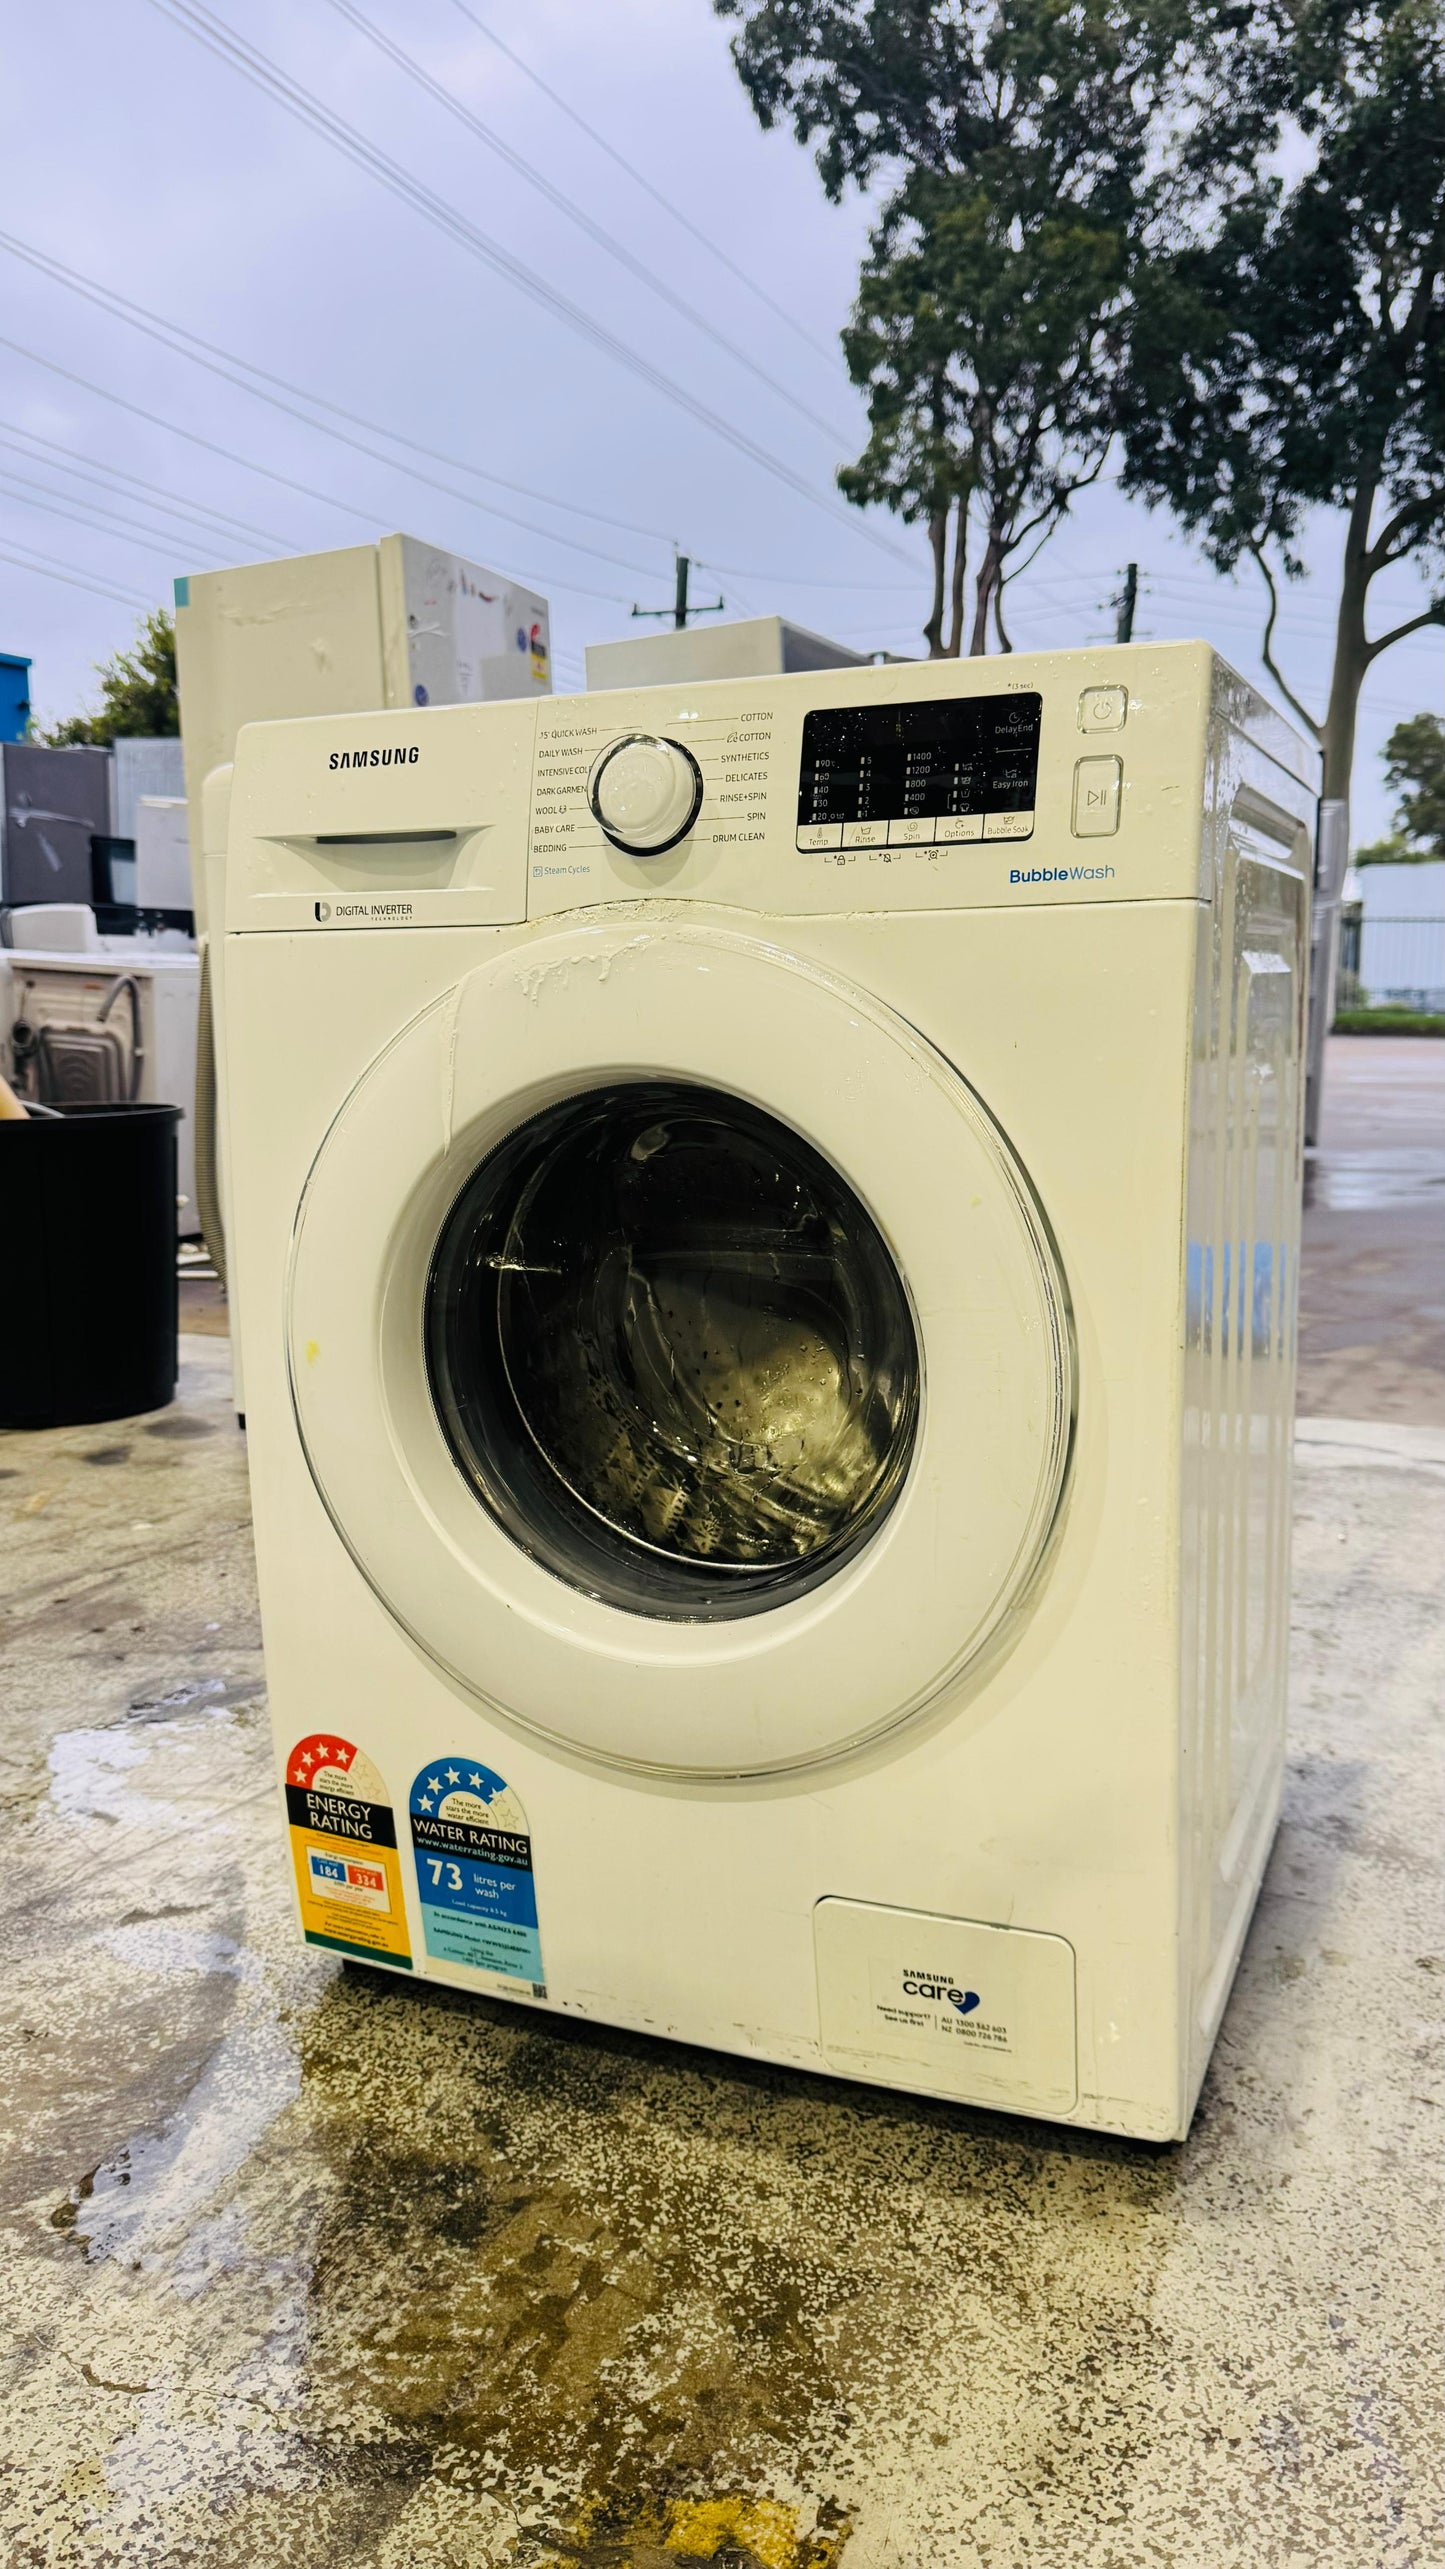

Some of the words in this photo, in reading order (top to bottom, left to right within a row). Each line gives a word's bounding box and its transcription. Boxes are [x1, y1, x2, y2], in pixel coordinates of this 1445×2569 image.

[740, 712, 774, 722] COTTON
[551, 729, 574, 739] QUICK
[575, 728, 598, 737] WASH
[994, 725, 1018, 735] Delay
[1018, 724, 1033, 732] End
[739, 732, 772, 742] COTTON
[328, 746, 420, 770] SAMSUNG
[538, 749, 560, 758] DAILY
[561, 748, 583, 757] WASH
[721, 752, 770, 763] SYNTHETICS
[912, 752, 932, 760] 1400
[537, 767, 574, 777] INTENSIVE
[912, 766, 931, 774] 1200
[725, 771, 768, 782] DELICATES
[910, 780, 926, 788] 800
[992, 781, 1012, 790] Easy
[1012, 780, 1029, 788] Iron
[536, 787, 556, 797] DARK
[556, 785, 588, 795] GARMEN
[818, 786, 829, 794] 40
[720, 792, 767, 803] RINSE+SPIN
[909, 793, 925, 801] 400
[535, 806, 558, 815] WOOL
[817, 812, 827, 820] 20
[747, 812, 766, 821] SPIN
[534, 825, 554, 834] BABY
[555, 824, 576, 833] CARE
[944, 829, 975, 839] Options
[987, 824, 1012, 835] Bubble
[712, 833, 737, 843] DRUM
[738, 832, 766, 842] CLEAN
[809, 838, 829, 847] Temp
[855, 835, 876, 844] Rinse
[903, 833, 921, 841] Spin
[533, 844, 567, 853] BEDDING
[544, 866, 567, 875] Steam
[568, 865, 591, 875] Cycles
[1009, 865, 1115, 884] BubbleWash
[336, 905, 370, 916] DIGITAL
[371, 904, 413, 915] INVERTER
[306, 1793, 371, 1821] ENERGY
[452, 1797, 464, 1806] The
[465, 1801, 482, 1809] more
[445, 1804, 461, 1813] stars
[472, 1810, 489, 1818] more
[447, 1812, 464, 1820] water
[310, 1811, 373, 1839] RATING
[413, 1818, 466, 1842] WATER
[469, 1830, 528, 1854] RATING
[416, 1836, 528, 1866] www.waterrating.gov.au
[319, 1865, 338, 1878] 184
[426, 1858, 463, 1891] 73
[356, 1873, 377, 1888] 334
[473, 1873, 498, 1887] litres
[500, 1881, 516, 1892] per
[475, 1887, 499, 1899] wash
[902, 1969, 954, 1985] SAMSUNG
[902, 1981, 964, 2003] care
[876, 2004, 897, 2014] Need
[941, 2016, 953, 2025] AU
[955, 2018, 975, 2028] 1300
[941, 2025, 952, 2034] NZ
[955, 2028, 977, 2038] 0800
